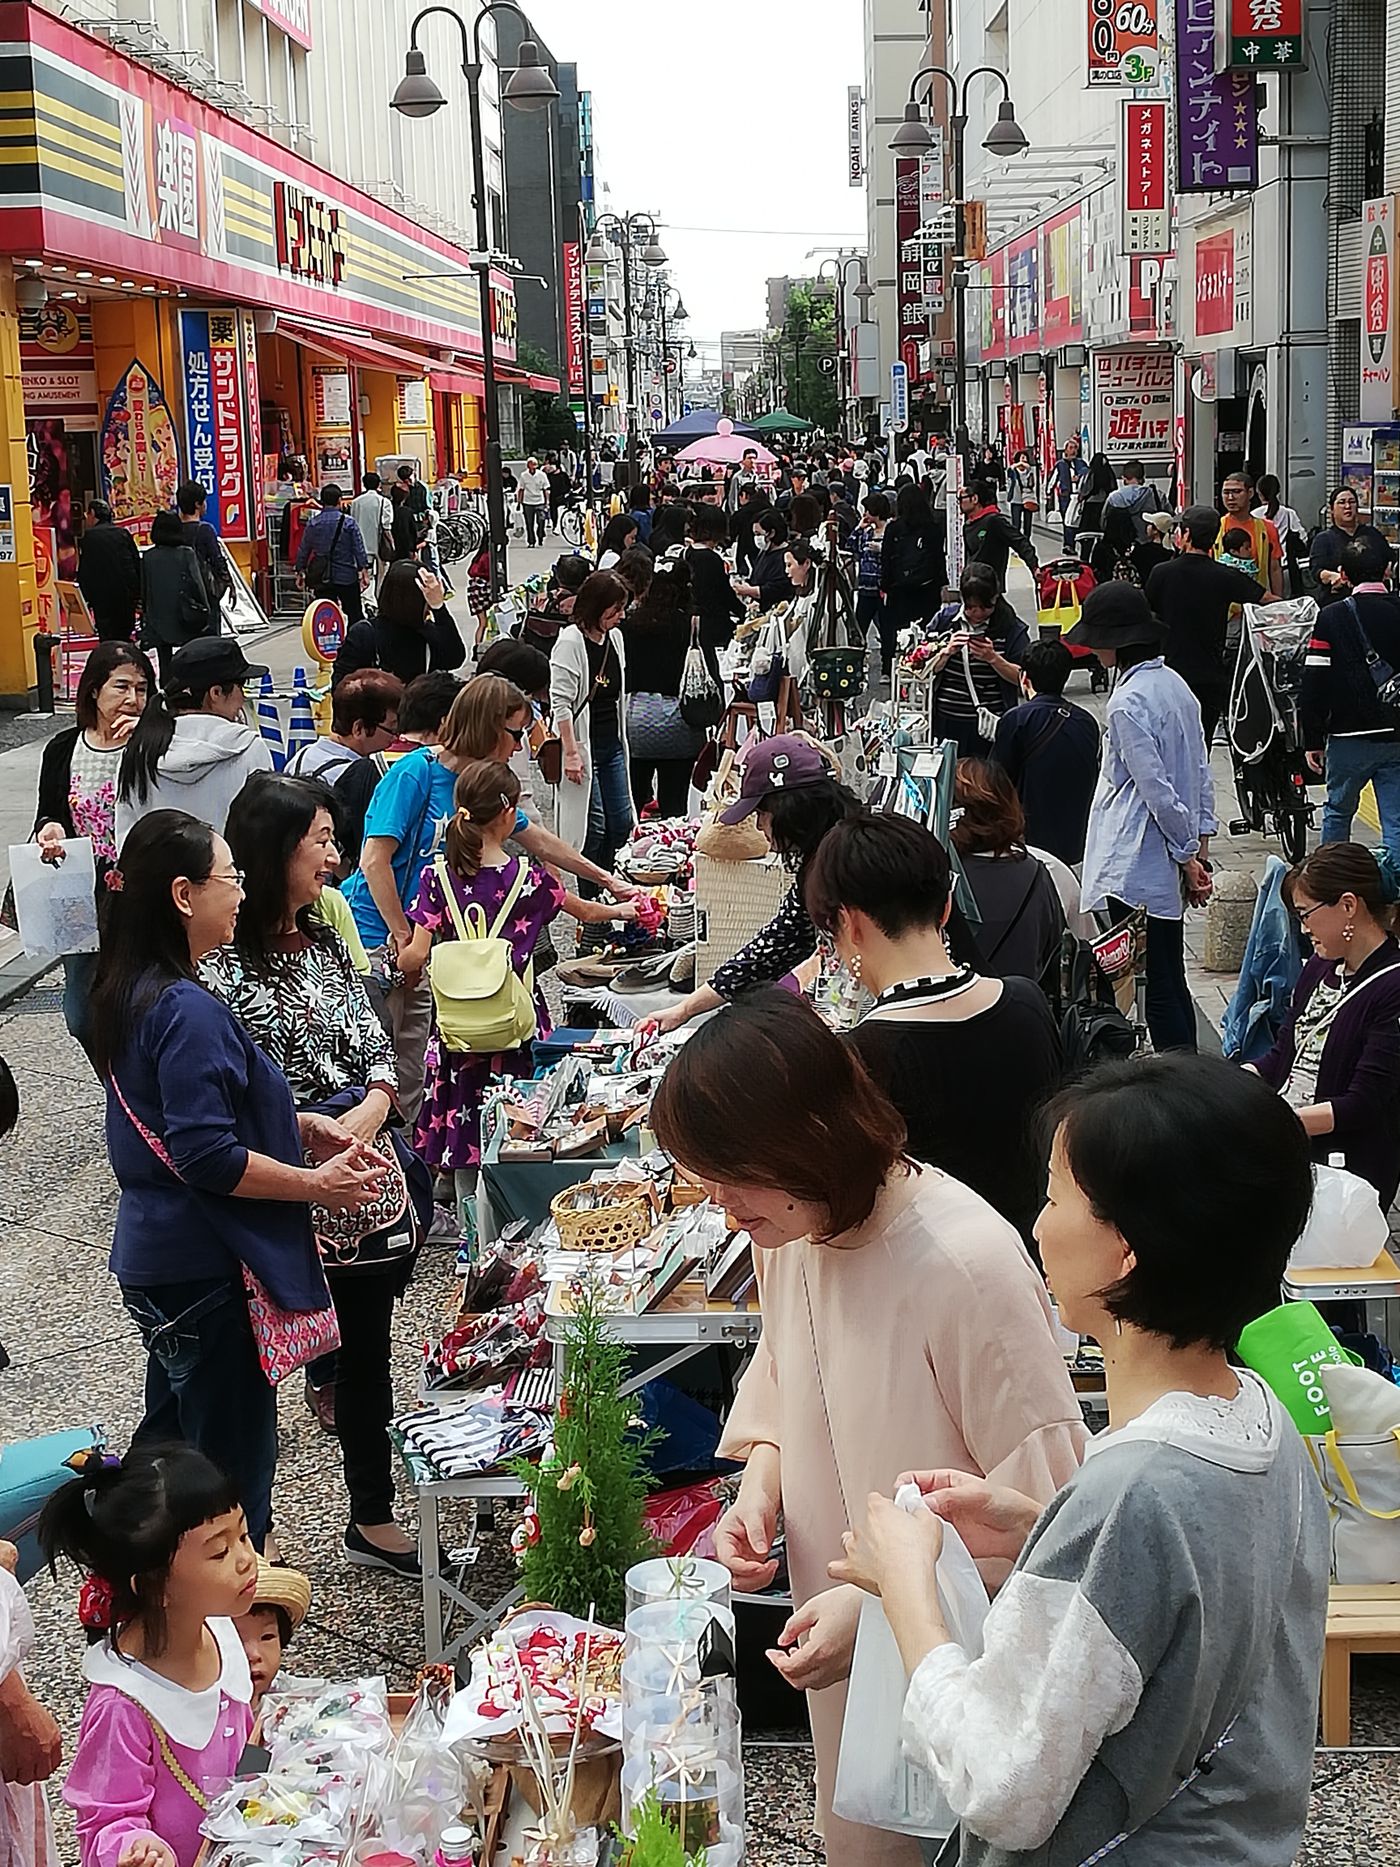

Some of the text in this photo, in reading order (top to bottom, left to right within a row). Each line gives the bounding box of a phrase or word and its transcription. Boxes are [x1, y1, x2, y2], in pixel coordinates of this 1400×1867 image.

[1115, 2, 1155, 35] 60分
[1125, 53, 1156, 83] 3F
[1242, 41, 1294, 64] 中華
[851, 101, 861, 180] NOAH ARKS
[1140, 108, 1154, 207] メガネストアー
[156, 118, 199, 240] 楽園
[901, 243, 927, 346] 静岡銀
[211, 317, 235, 344] 薬
[38, 391, 80, 400] AMUSEMENT
[57, 376, 79, 385] SLOT
[188, 351, 215, 496] 処方せん受付
[213, 350, 242, 498] サンドラッグ
[1292, 1359, 1331, 1417] FOOT
